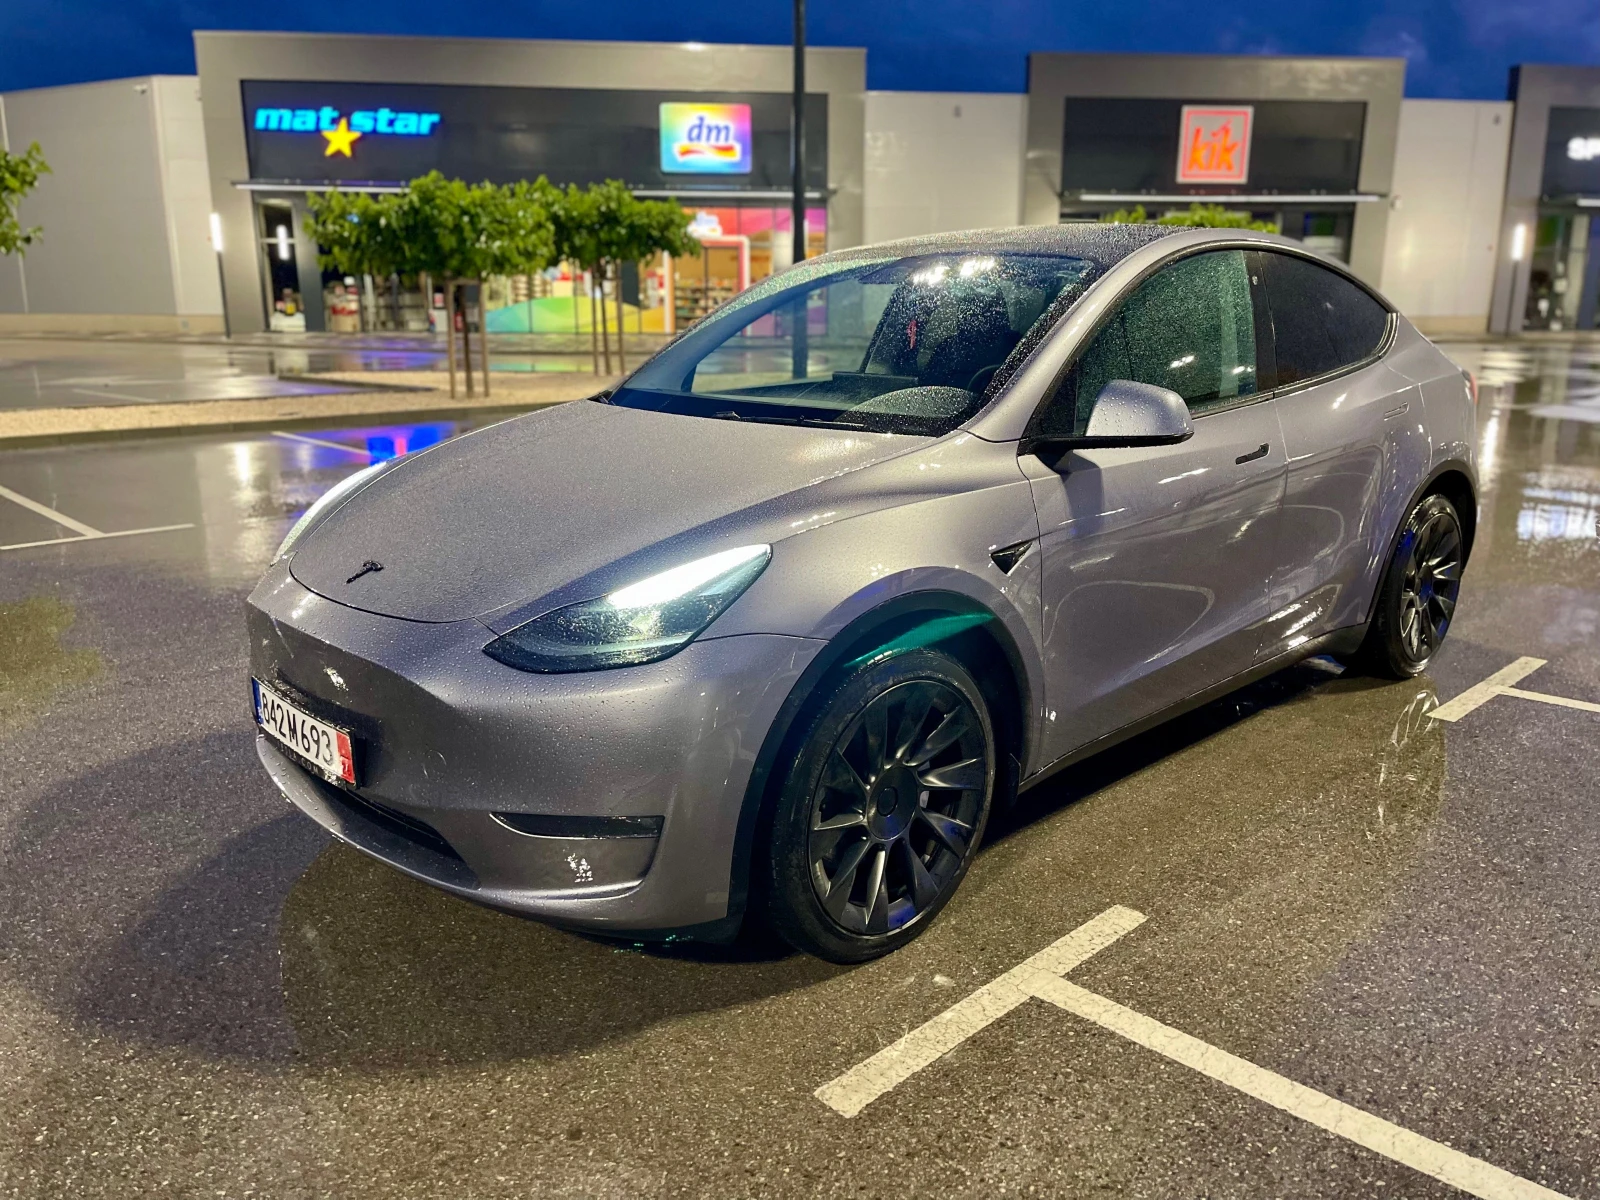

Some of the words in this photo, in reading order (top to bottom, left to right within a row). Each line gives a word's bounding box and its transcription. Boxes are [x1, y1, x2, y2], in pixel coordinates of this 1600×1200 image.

[254, 106, 339, 131] mat
[350, 108, 441, 135] star
[687, 115, 731, 142] dm
